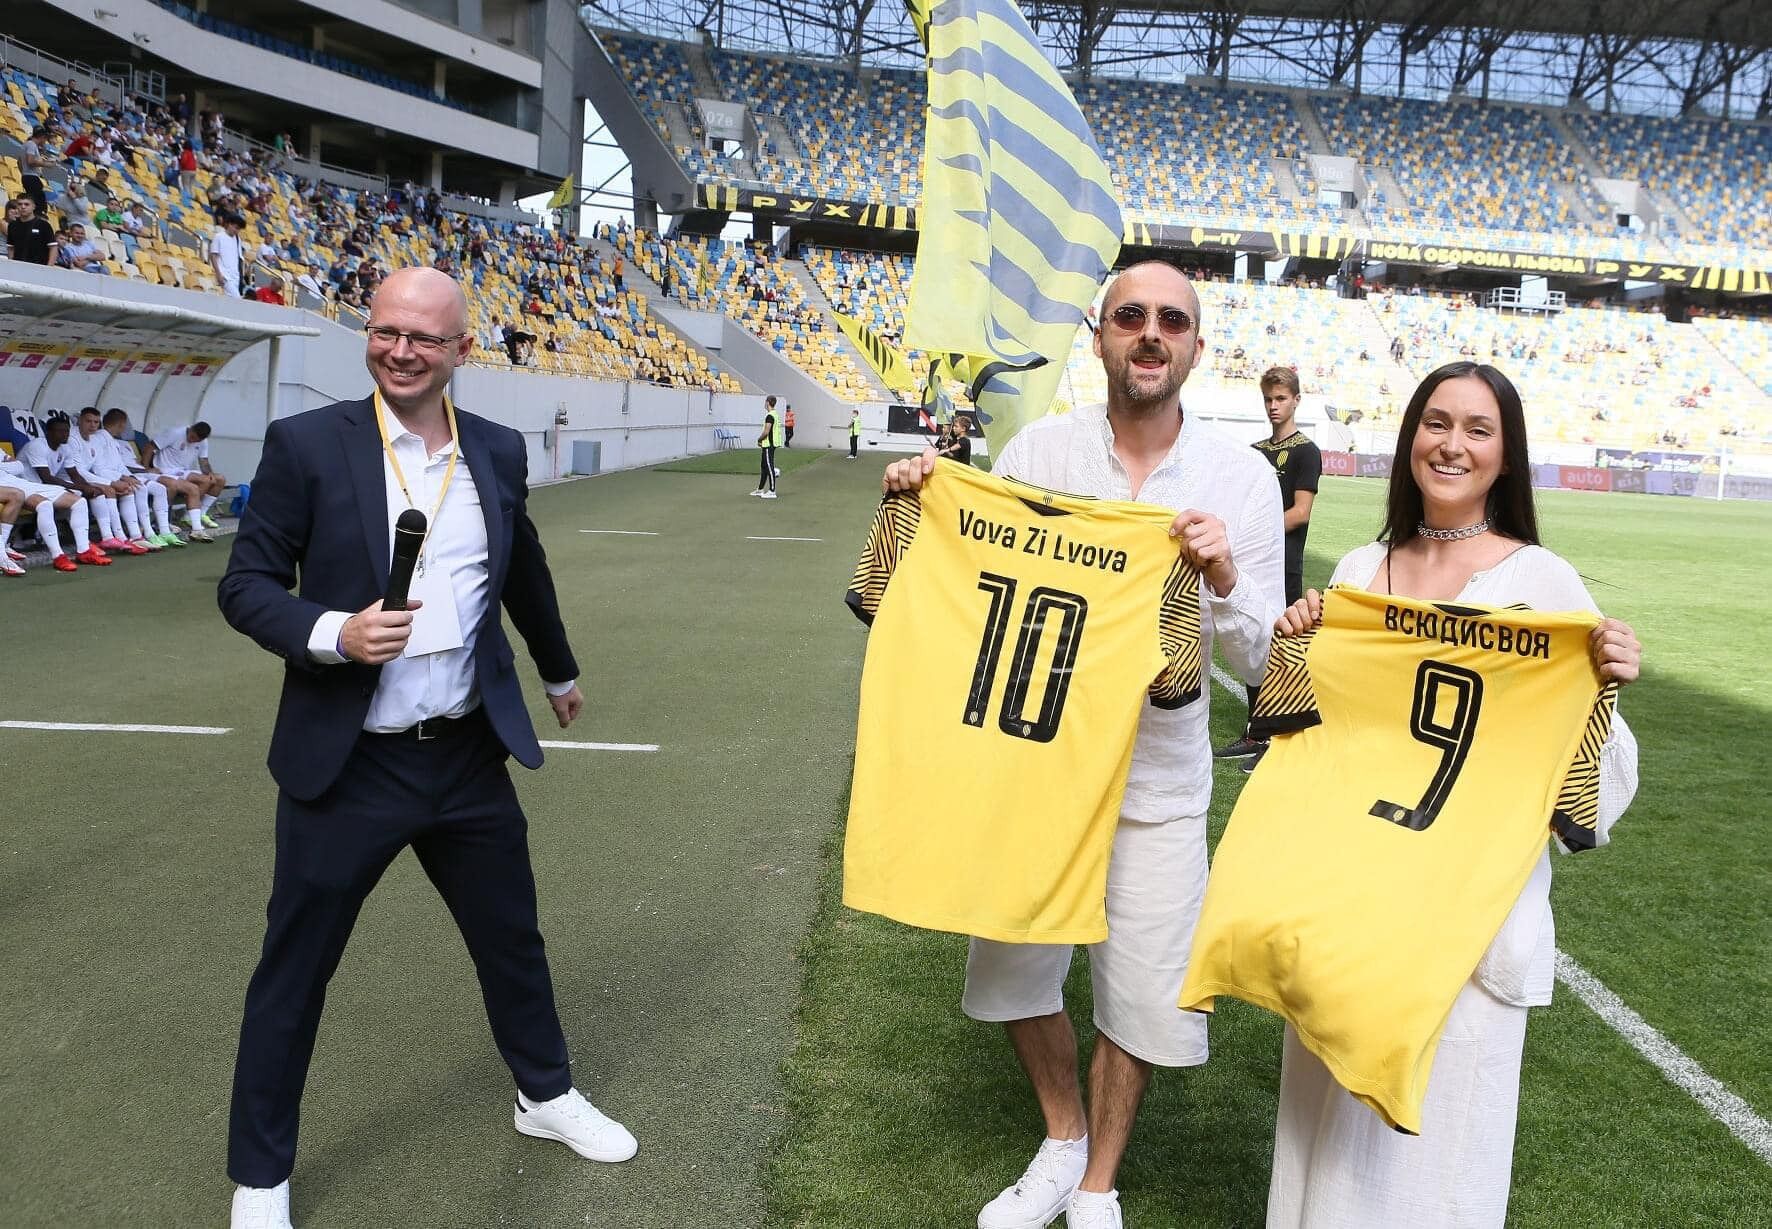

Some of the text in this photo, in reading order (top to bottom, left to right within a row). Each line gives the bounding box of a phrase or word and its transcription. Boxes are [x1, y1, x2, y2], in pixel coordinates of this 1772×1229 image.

[752, 195, 851, 217] РУХ
[1219, 232, 1241, 245] TV
[1371, 243, 1585, 273] НОВА ОБОРОНА ЛЬВОВА
[1596, 262, 1686, 281] РУХ
[1321, 457, 1347, 470] uto
[1567, 471, 1602, 485] auto
[959, 508, 1128, 573] Vova Zi Lvova
[1385, 604, 1550, 659] ВСЮДИСВОЯ
[962, 571, 1088, 743] 10
[1368, 660, 1483, 831] 9
